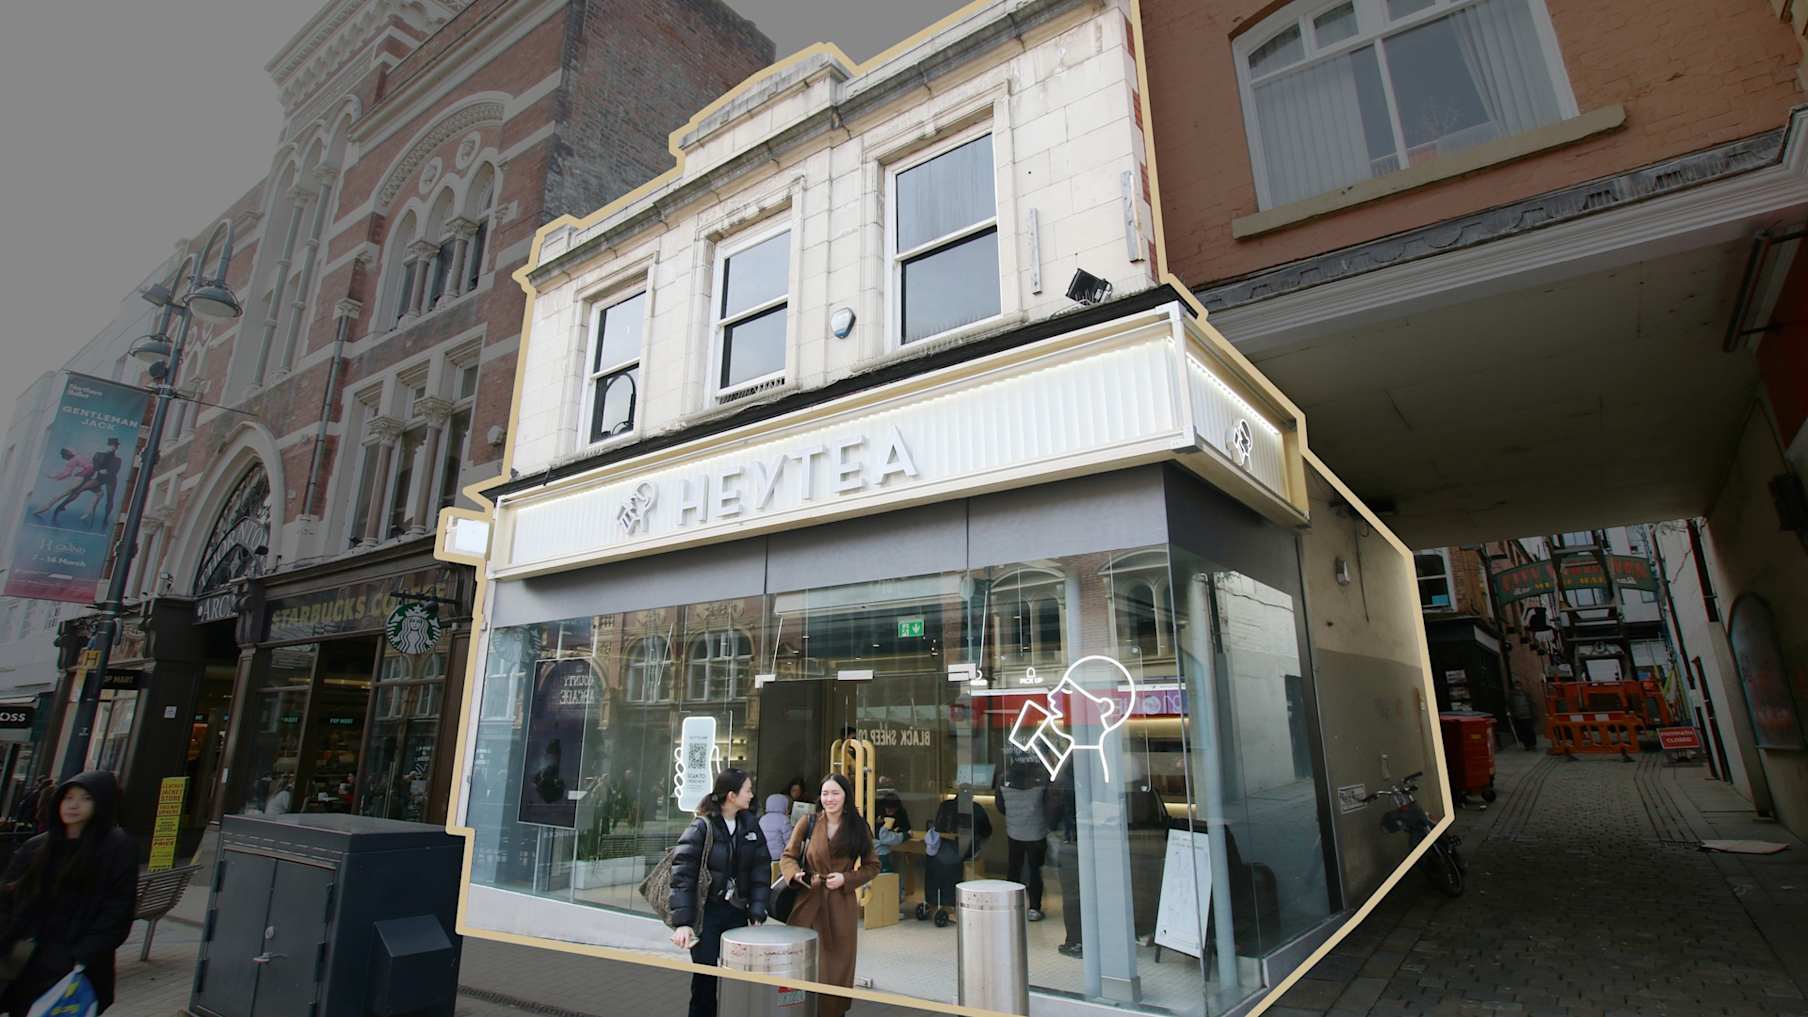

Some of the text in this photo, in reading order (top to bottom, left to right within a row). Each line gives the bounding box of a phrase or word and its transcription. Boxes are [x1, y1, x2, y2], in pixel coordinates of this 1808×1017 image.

[62, 405, 139, 430] GENTLEMAN
[80, 418, 115, 431] JACK
[677, 424, 919, 526] HEYTEA
[272, 596, 367, 626] STARBUCKS
